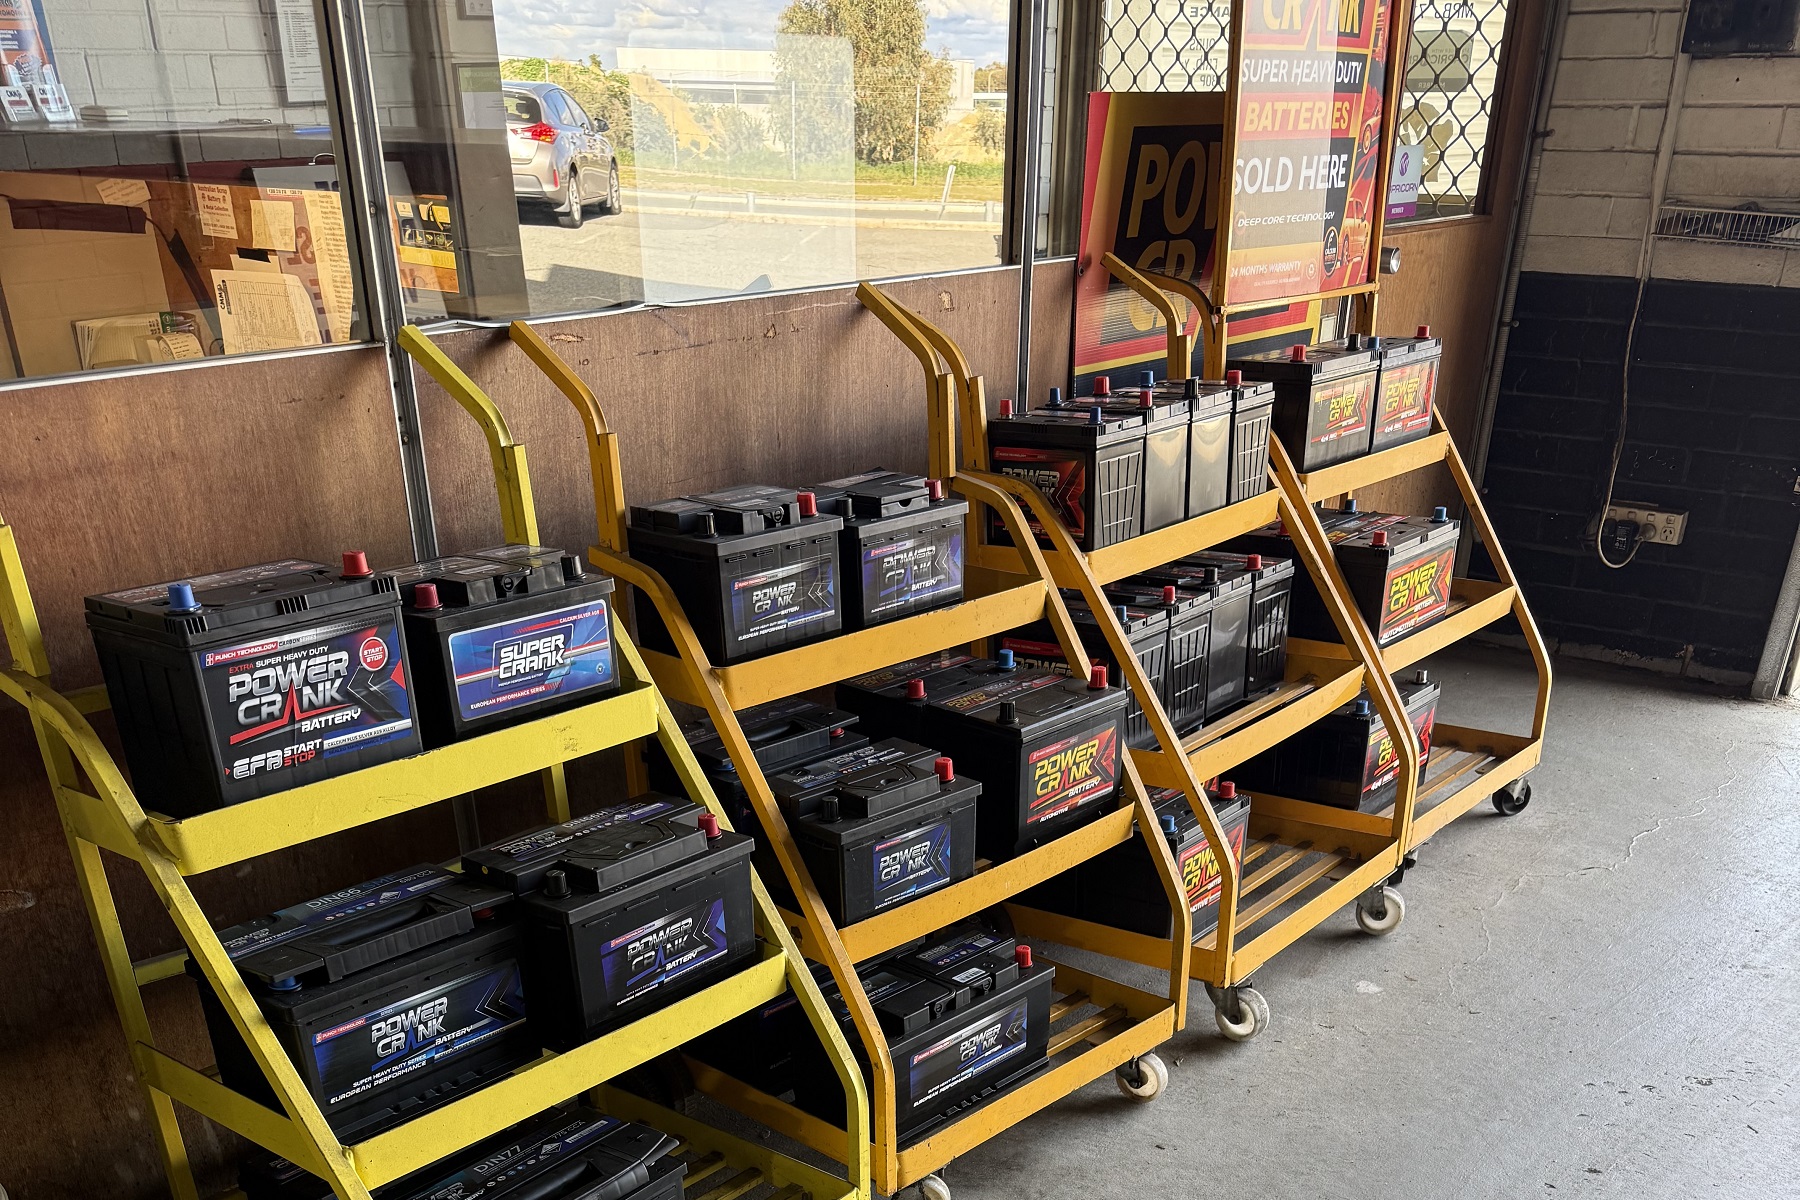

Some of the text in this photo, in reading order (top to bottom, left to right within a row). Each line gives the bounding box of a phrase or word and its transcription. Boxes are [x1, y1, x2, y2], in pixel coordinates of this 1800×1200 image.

[1242, 58, 1363, 85] SUPER HEAVY DUTY
[1243, 100, 1350, 132] BATTERIES
[1235, 154, 1349, 195] SOLD HERE
[1238, 211, 1335, 227] DEEP CORE TECHNOLOGY
[1231, 260, 1302, 277] 24 MONTHS WARRANTY
[1330, 392, 1357, 411] POWER
[1386, 378, 1420, 398] POWER
[752, 581, 797, 604] POWER
[911, 577, 938, 591] BATTERY
[1390, 561, 1438, 596] POWER
[1390, 578, 1432, 612] CRANK
[215, 651, 236, 661] PUNCH
[237, 643, 277, 656] TECHNOLOGY
[229, 645, 328, 674] EXTRA SUPER HEAVY DUTY
[363, 646, 384, 656] START
[366, 653, 383, 663] STOP
[500, 633, 565, 664] SUPER
[229, 651, 349, 703] POWER
[499, 648, 565, 679] CRANK
[237, 677, 345, 727] CRANK
[470, 685, 546, 710] EUROPEAN PERFORMANCE SERIES
[301, 707, 362, 733] BATTERY
[327, 739, 347, 747] CALCIUM
[233, 738, 323, 779] EFB START
[284, 750, 316, 767] STOP
[1034, 739, 1099, 780] POWER
[1036, 757, 1093, 796] CRANK
[1068, 779, 1101, 798] BATTERY
[1040, 806, 1069, 823] AUTOMOTIVE
[879, 841, 931, 872] POWER
[305, 887, 362, 908] DIN66
[627, 917, 693, 961] POWER
[665, 949, 698, 971] BATTERY
[322, 1029, 338, 1039] PUNCH
[337, 1019, 365, 1033] TECHNOLOGY
[371, 997, 448, 1043] POWER
[376, 1015, 446, 1058] CRANK
[435, 1025, 474, 1046] BATTERY
[959, 1023, 1002, 1054] POWER
[330, 1060, 427, 1104] EUROPEAN PERFORMANCE
[352, 1053, 427, 1088] SUPER HEAVY DUTY SERIES
[913, 1072, 972, 1108] EUROPEAN PERFORMANCE
[473, 1144, 521, 1173] DIN77
